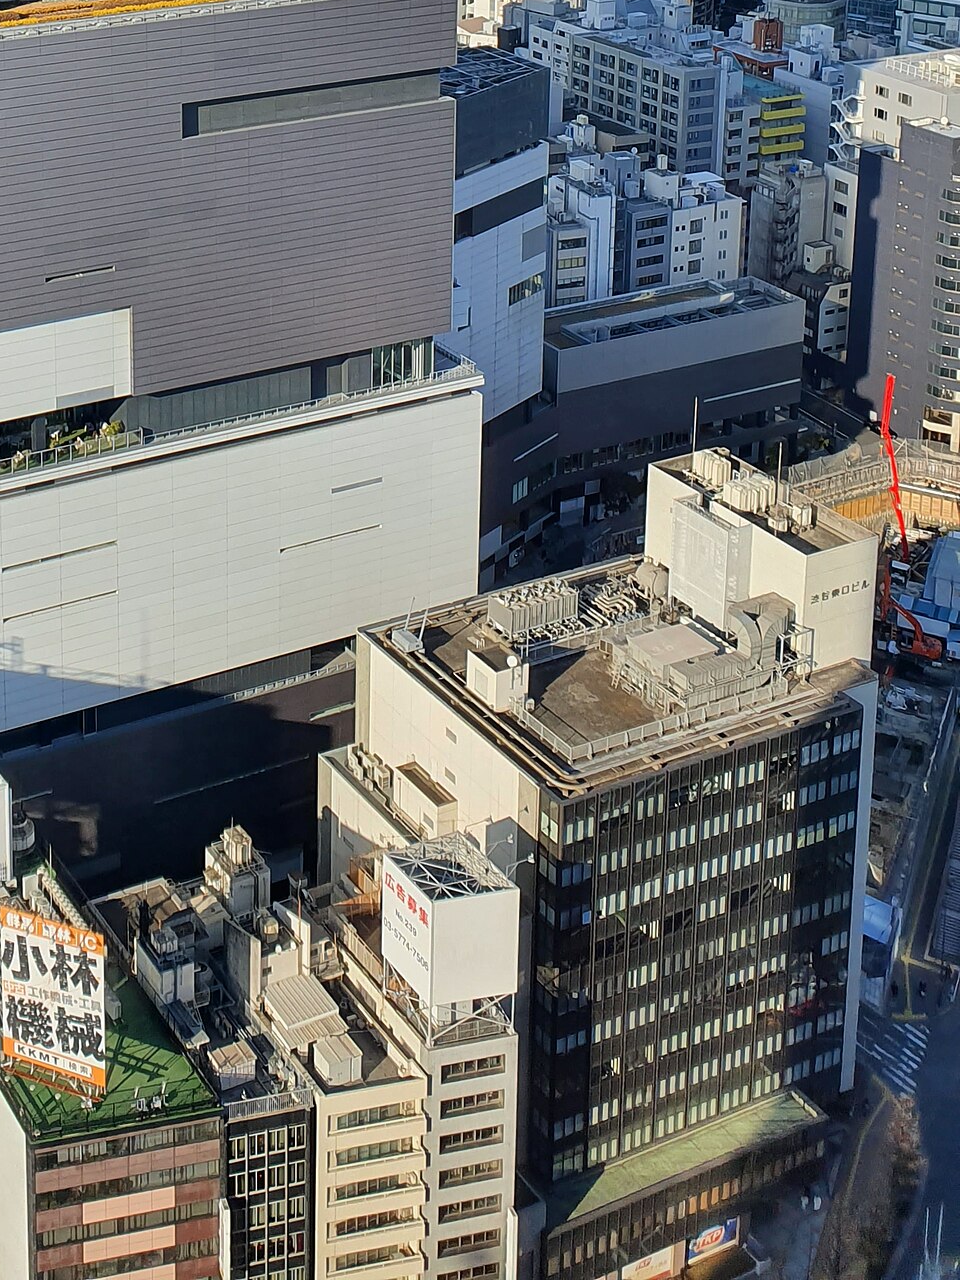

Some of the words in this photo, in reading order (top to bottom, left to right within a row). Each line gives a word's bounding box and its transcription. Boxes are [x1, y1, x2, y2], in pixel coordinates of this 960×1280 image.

[384, 871, 429, 928] 広告募集
[1, 934, 100, 998] 小林
[5, 994, 105, 1062] 機械
[17, 1044, 59, 1066] KKMT
[695, 1226, 724, 1251] TKP
